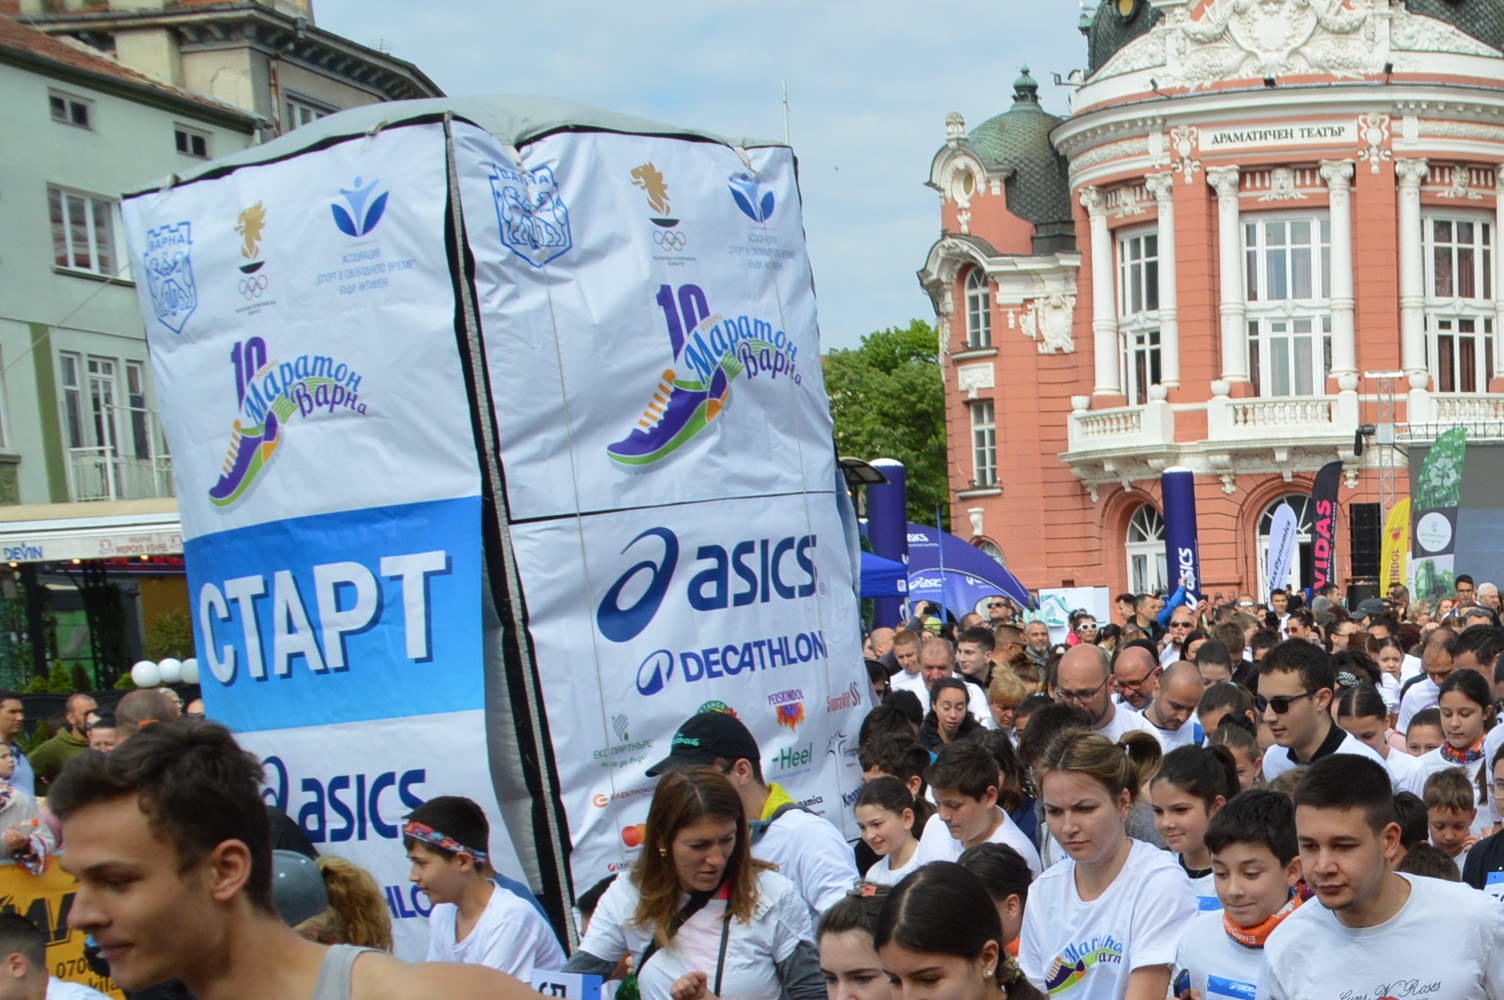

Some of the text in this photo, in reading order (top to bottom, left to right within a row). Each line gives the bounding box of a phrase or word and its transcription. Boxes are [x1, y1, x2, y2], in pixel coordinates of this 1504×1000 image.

[1211, 126, 1345, 145] ДРАМАТИЧЕН ТЕАТЪР
[684, 315, 797, 385] Маратон
[737, 341, 802, 384] Варна
[244, 354, 362, 428] Маратон
[290, 381, 368, 418] Варна
[3, 546, 43, 561] DEVIN
[1313, 499, 1332, 590] VIDAS
[199, 550, 451, 684] СТАРТ
[679, 631, 827, 683] DECATHLON
